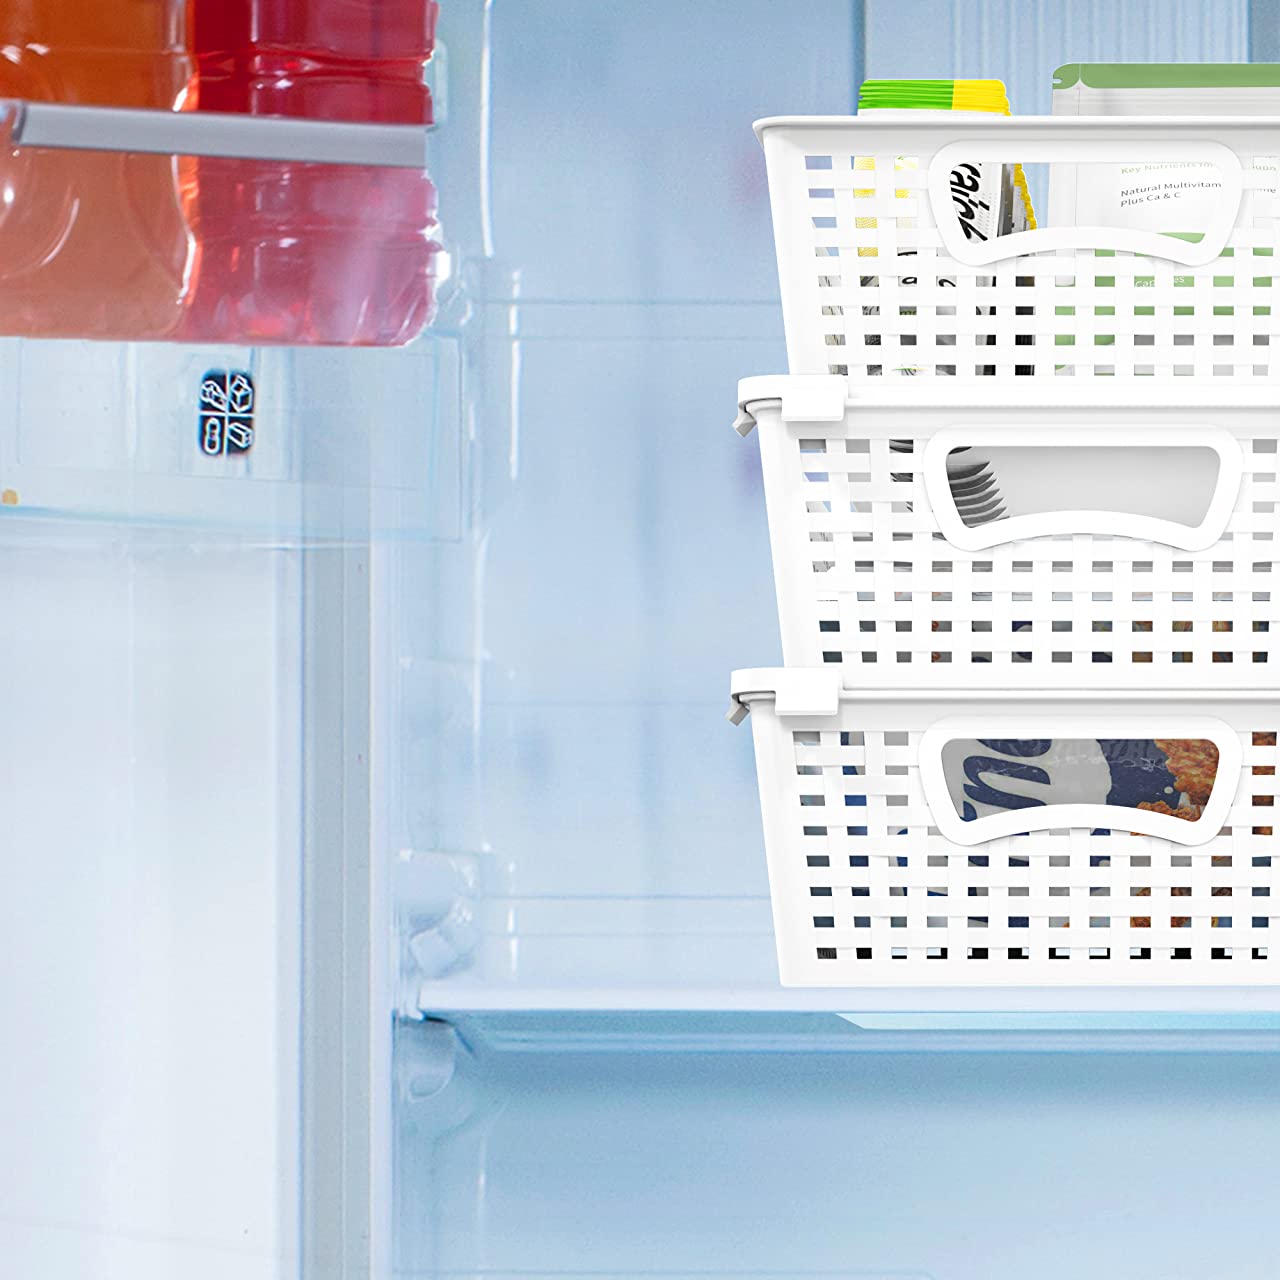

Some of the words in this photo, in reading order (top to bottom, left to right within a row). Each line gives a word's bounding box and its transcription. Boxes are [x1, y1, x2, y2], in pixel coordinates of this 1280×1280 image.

[1121, 166, 1141, 175] Key
[1144, 162, 1197, 171] Nutrients
[1120, 183, 1161, 197] Natural
[1120, 197, 1144, 208] Plus
[1146, 193, 1161, 202] Ca
[1163, 192, 1171, 200] &
[1173, 191, 1182, 199] C
